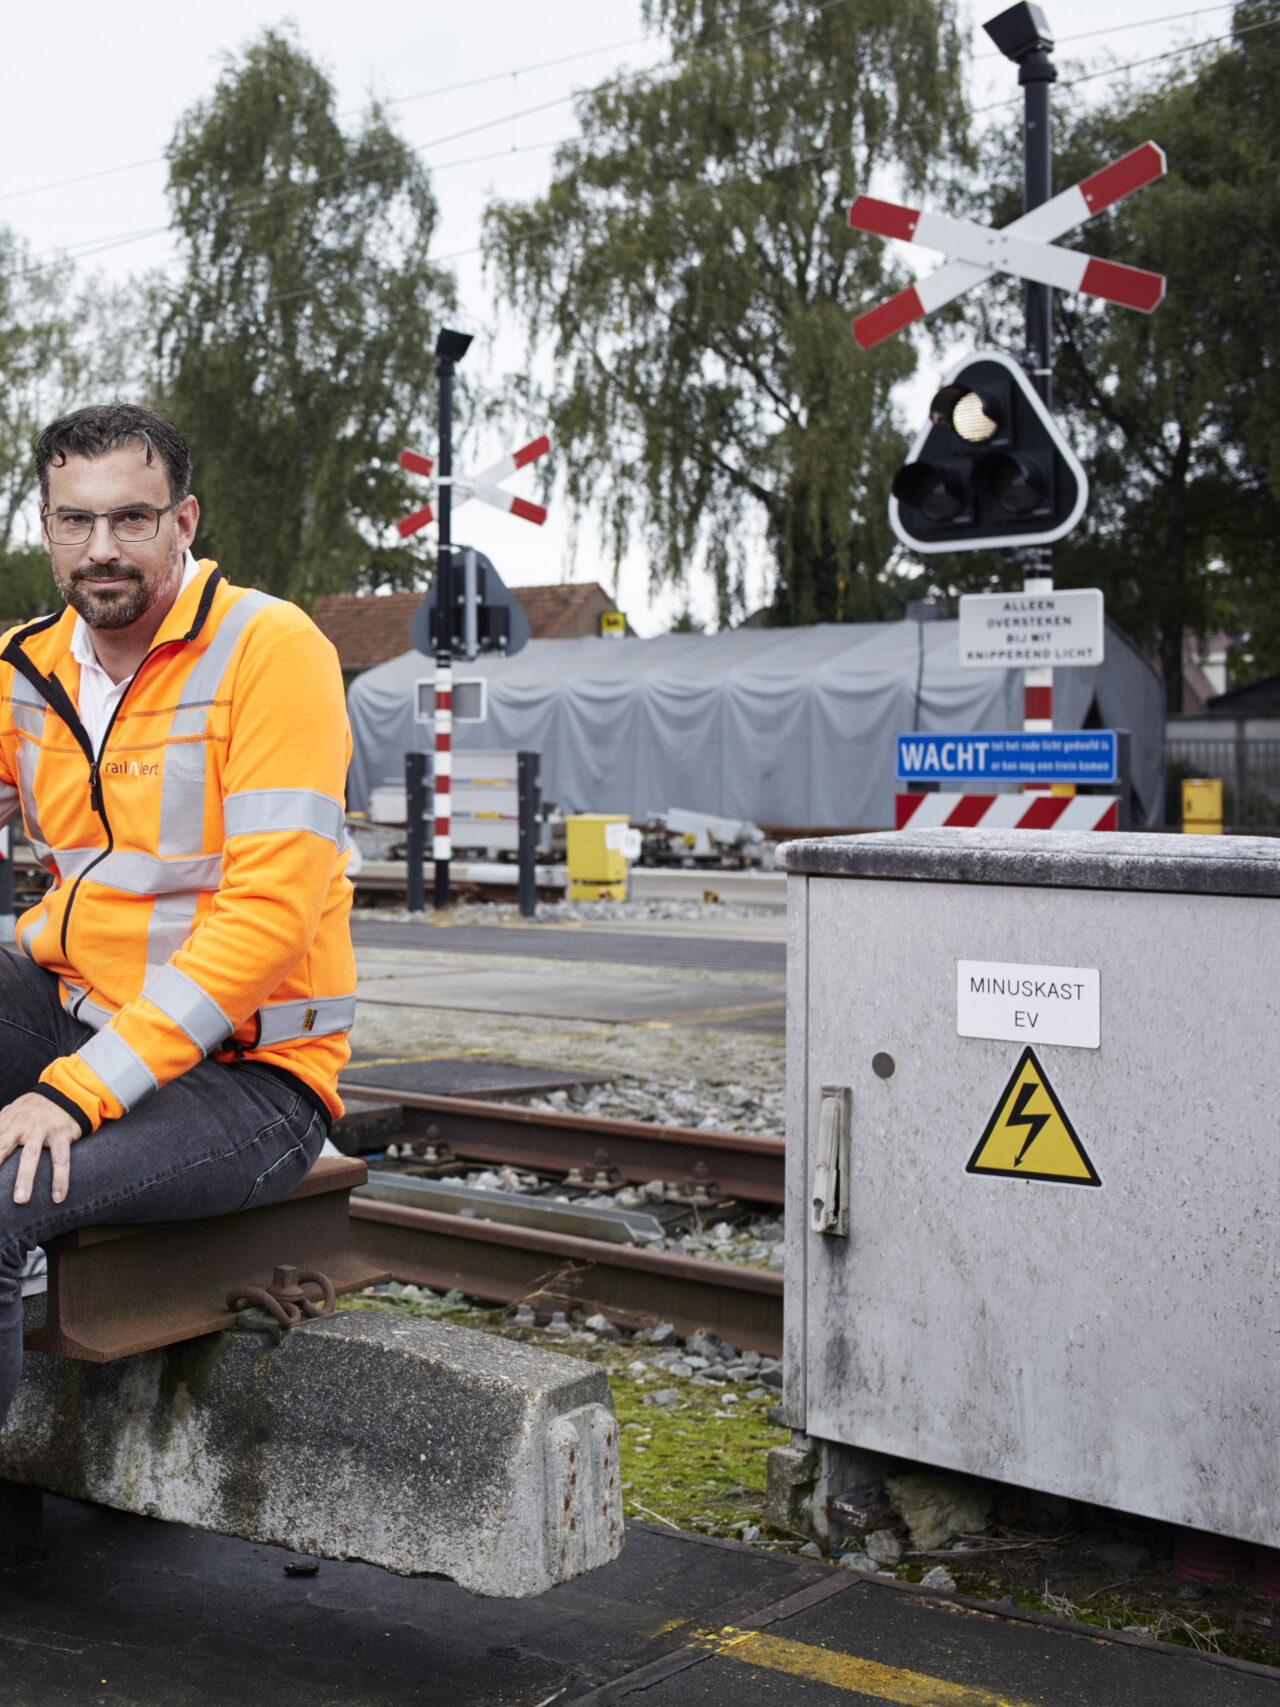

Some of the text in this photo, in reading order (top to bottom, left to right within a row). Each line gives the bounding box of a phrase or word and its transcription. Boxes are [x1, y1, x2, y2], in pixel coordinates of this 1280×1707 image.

[1003, 600, 1055, 612] ALLEEN
[986, 616, 1072, 628] OVERSTEKEN
[1006, 633, 1027, 644] BIJ
[967, 648, 1093, 660] KNIPPEREND LICHT
[901, 742, 989, 771] WACHT
[970, 976, 1085, 1000] MINUSKAST
[1015, 1010, 1039, 1028] EV
